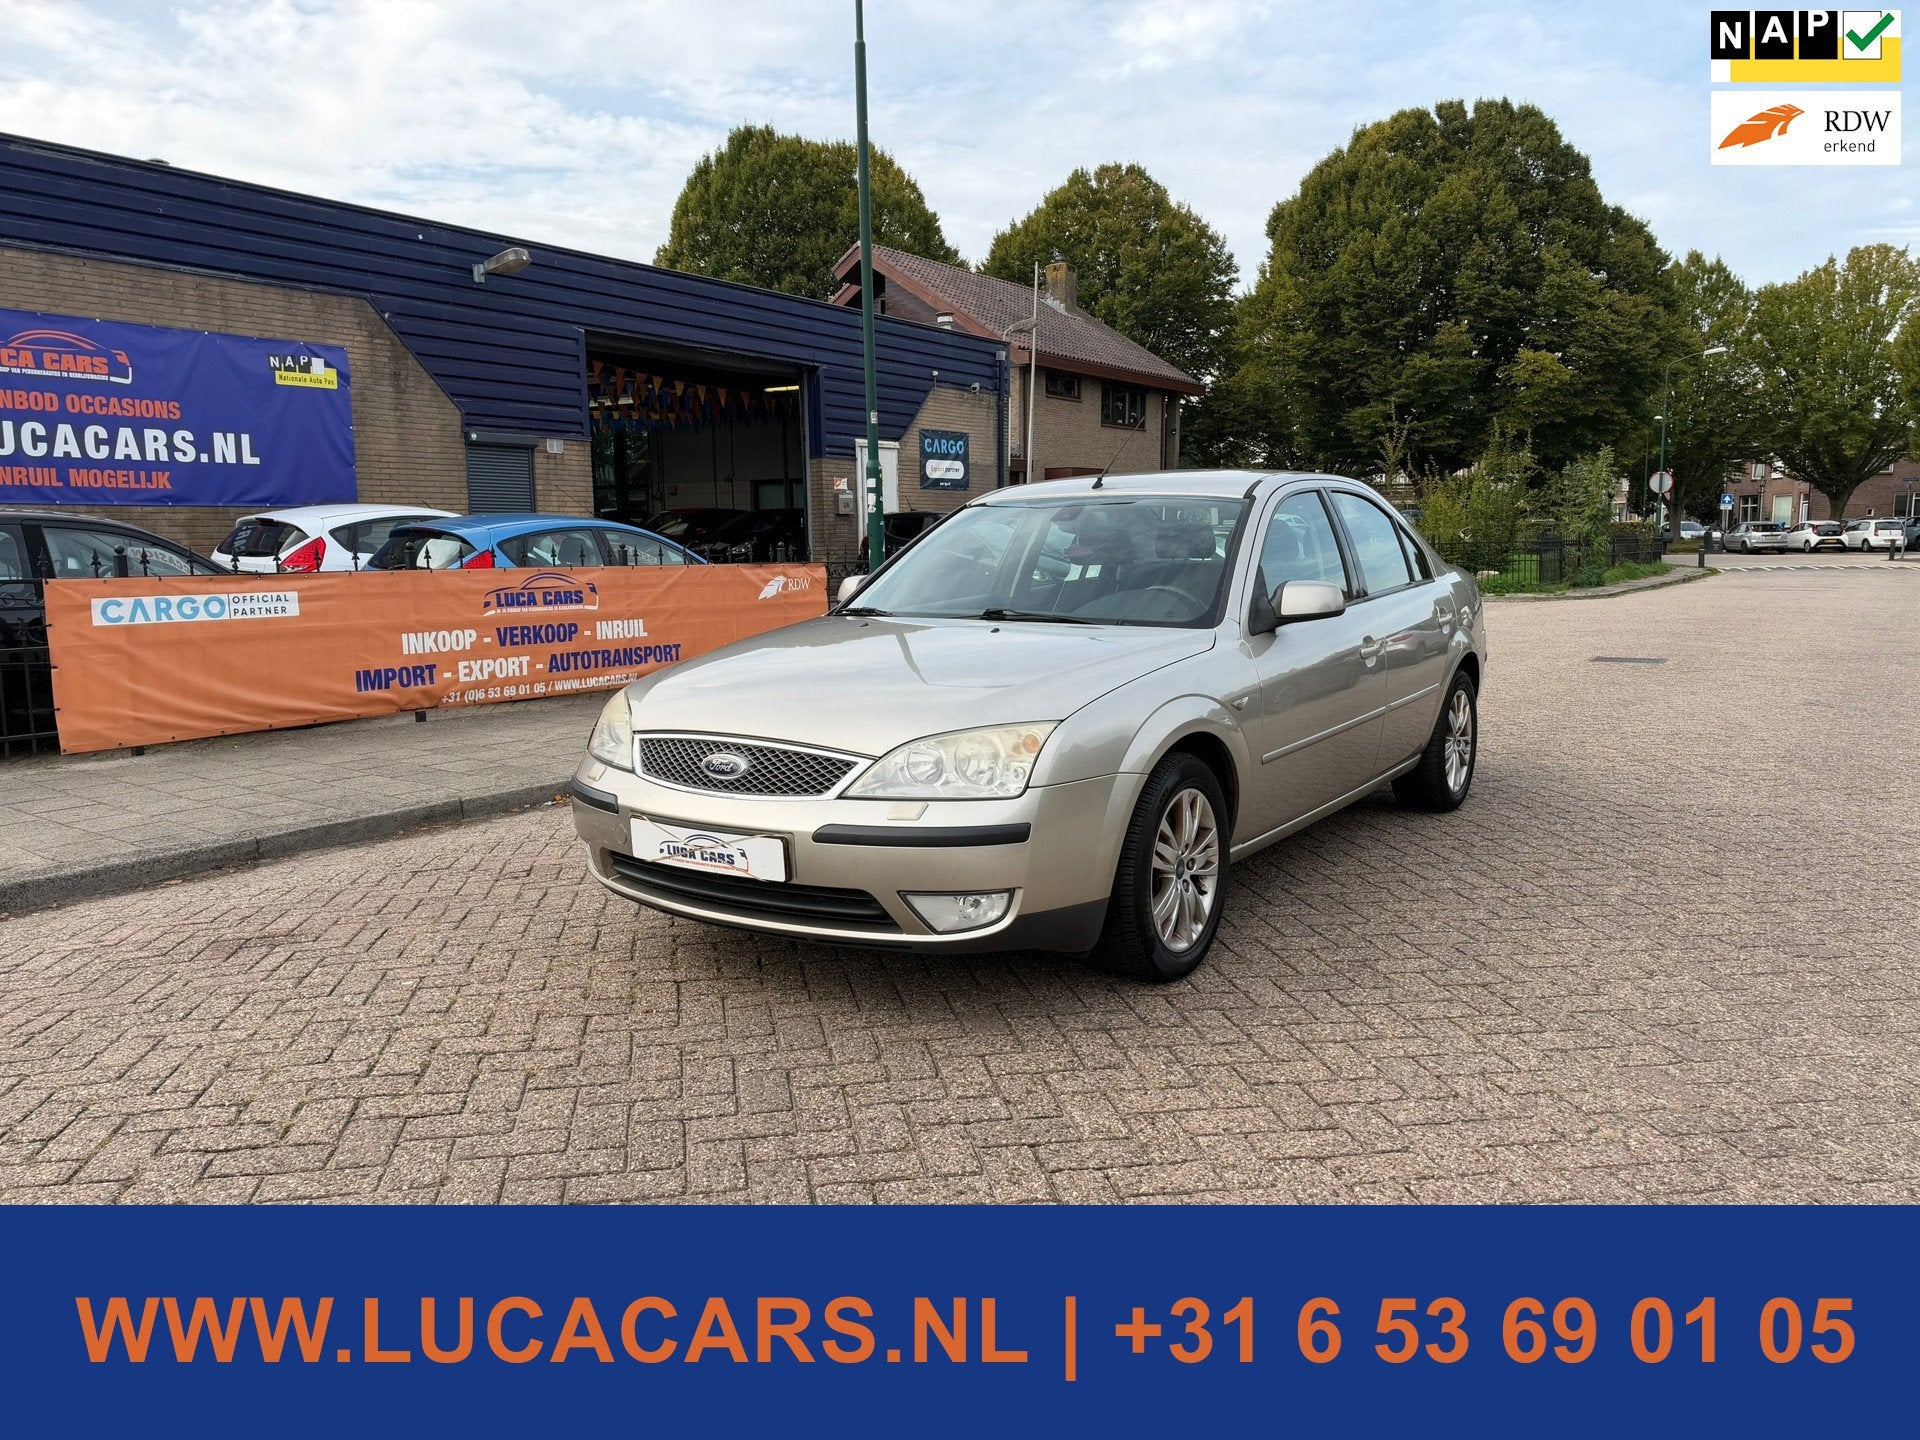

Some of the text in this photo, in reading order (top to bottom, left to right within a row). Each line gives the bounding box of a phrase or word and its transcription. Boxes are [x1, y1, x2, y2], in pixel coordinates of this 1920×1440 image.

[43, 352, 109, 375] CARS
[269, 355, 308, 368] NAP
[278, 373, 335, 386] Nationale Auto Pas
[66, 394, 181, 420] OCCASIONS
[924, 438, 965, 455] CARGO
[69, 469, 172, 489] MOGELIJK
[788, 578, 811, 590] RDW
[496, 590, 584, 607] LUCA CARS
[101, 594, 290, 624] CARGO OFFICIAL
[233, 606, 288, 616] PARTNER
[401, 629, 477, 655] INKOOP
[496, 622, 579, 647] VERKOOP
[596, 619, 648, 640] INRUIL
[355, 664, 437, 692] IMPORT
[458, 656, 530, 682] EXPORT
[548, 643, 682, 673] AUTOTRANSPORT
[441, 691, 460, 704] +31
[464, 688, 485, 703] (0)6
[487, 686, 501, 699] 53
[503, 685, 517, 697] 69
[518, 683, 530, 695] 01
[533, 682, 546, 693] 05
[709, 758, 734, 772] Ford
[667, 844, 697, 859] LUCA
[701, 849, 735, 865] CARS
